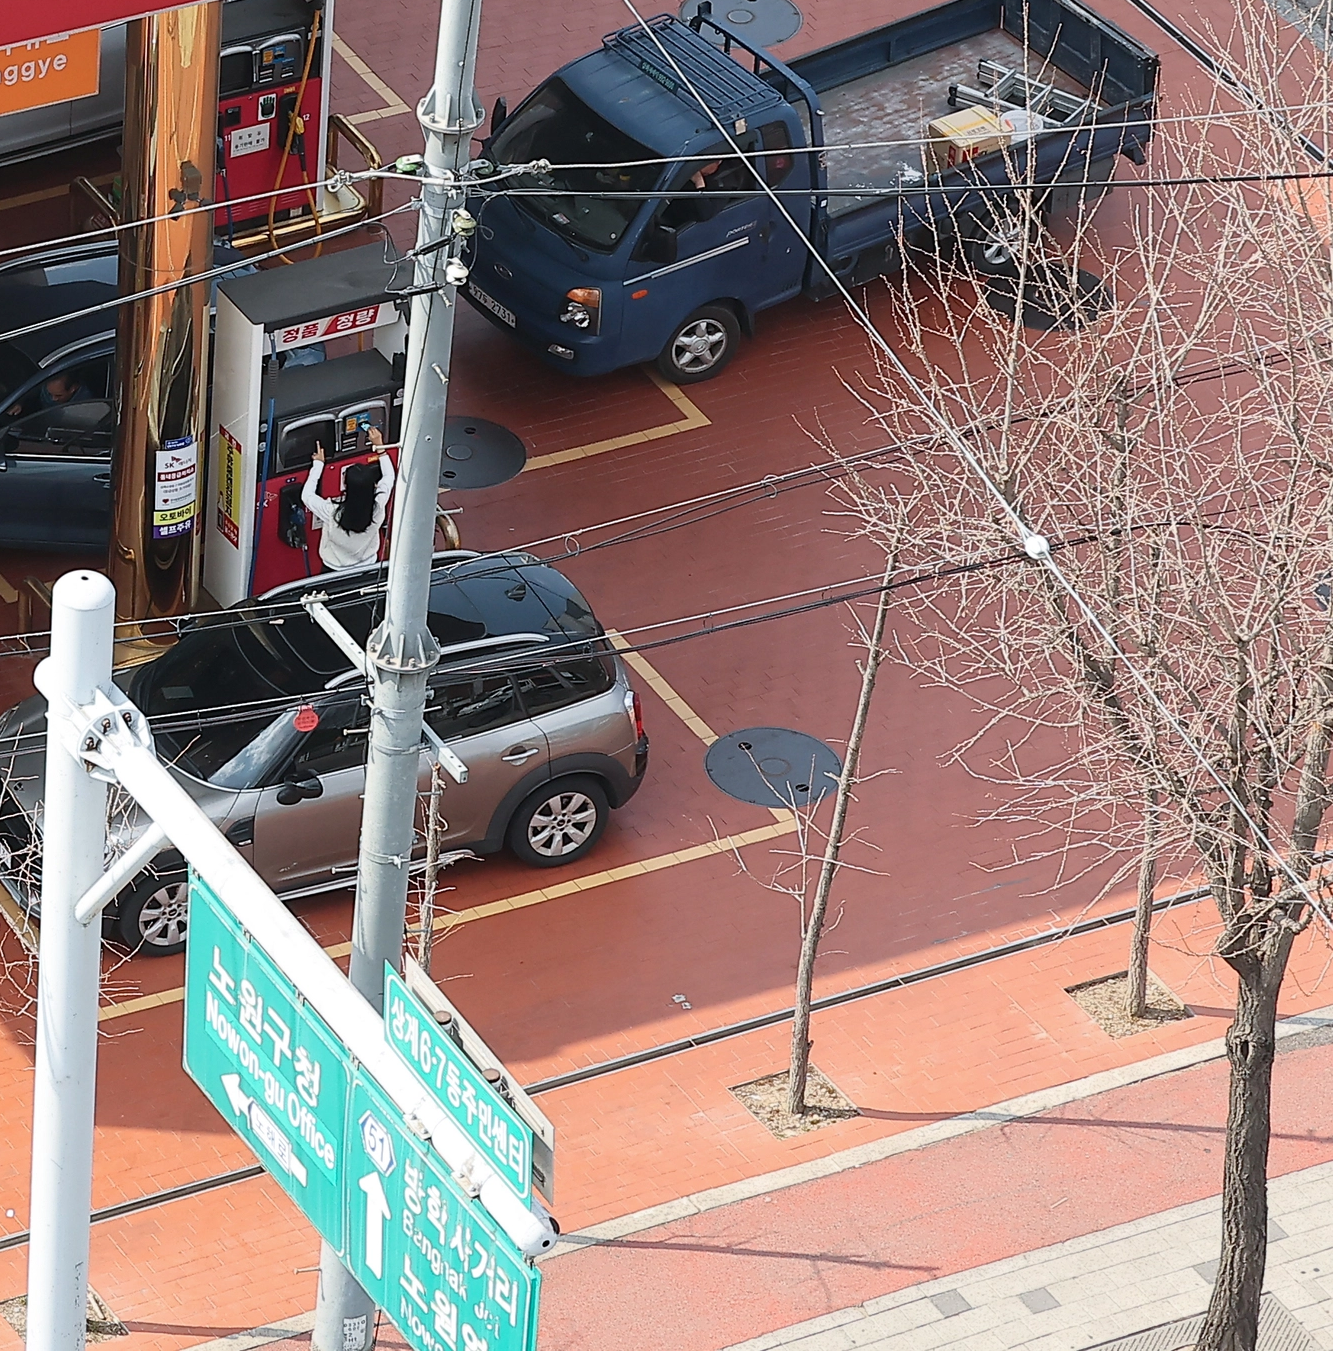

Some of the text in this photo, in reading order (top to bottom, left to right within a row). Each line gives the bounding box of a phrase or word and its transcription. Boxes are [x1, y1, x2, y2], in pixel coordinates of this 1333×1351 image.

[282, 309, 374, 344] 정품 정량
[159, 506, 192, 521] 오토바이
[159, 519, 192, 536] 셀프주유
[208, 944, 321, 1108] 노원구청
[205, 990, 335, 1170] Nowon-gu Office
[365, 1123, 386, 1153] 51
[403, 1158, 519, 1328] 방학사거리
